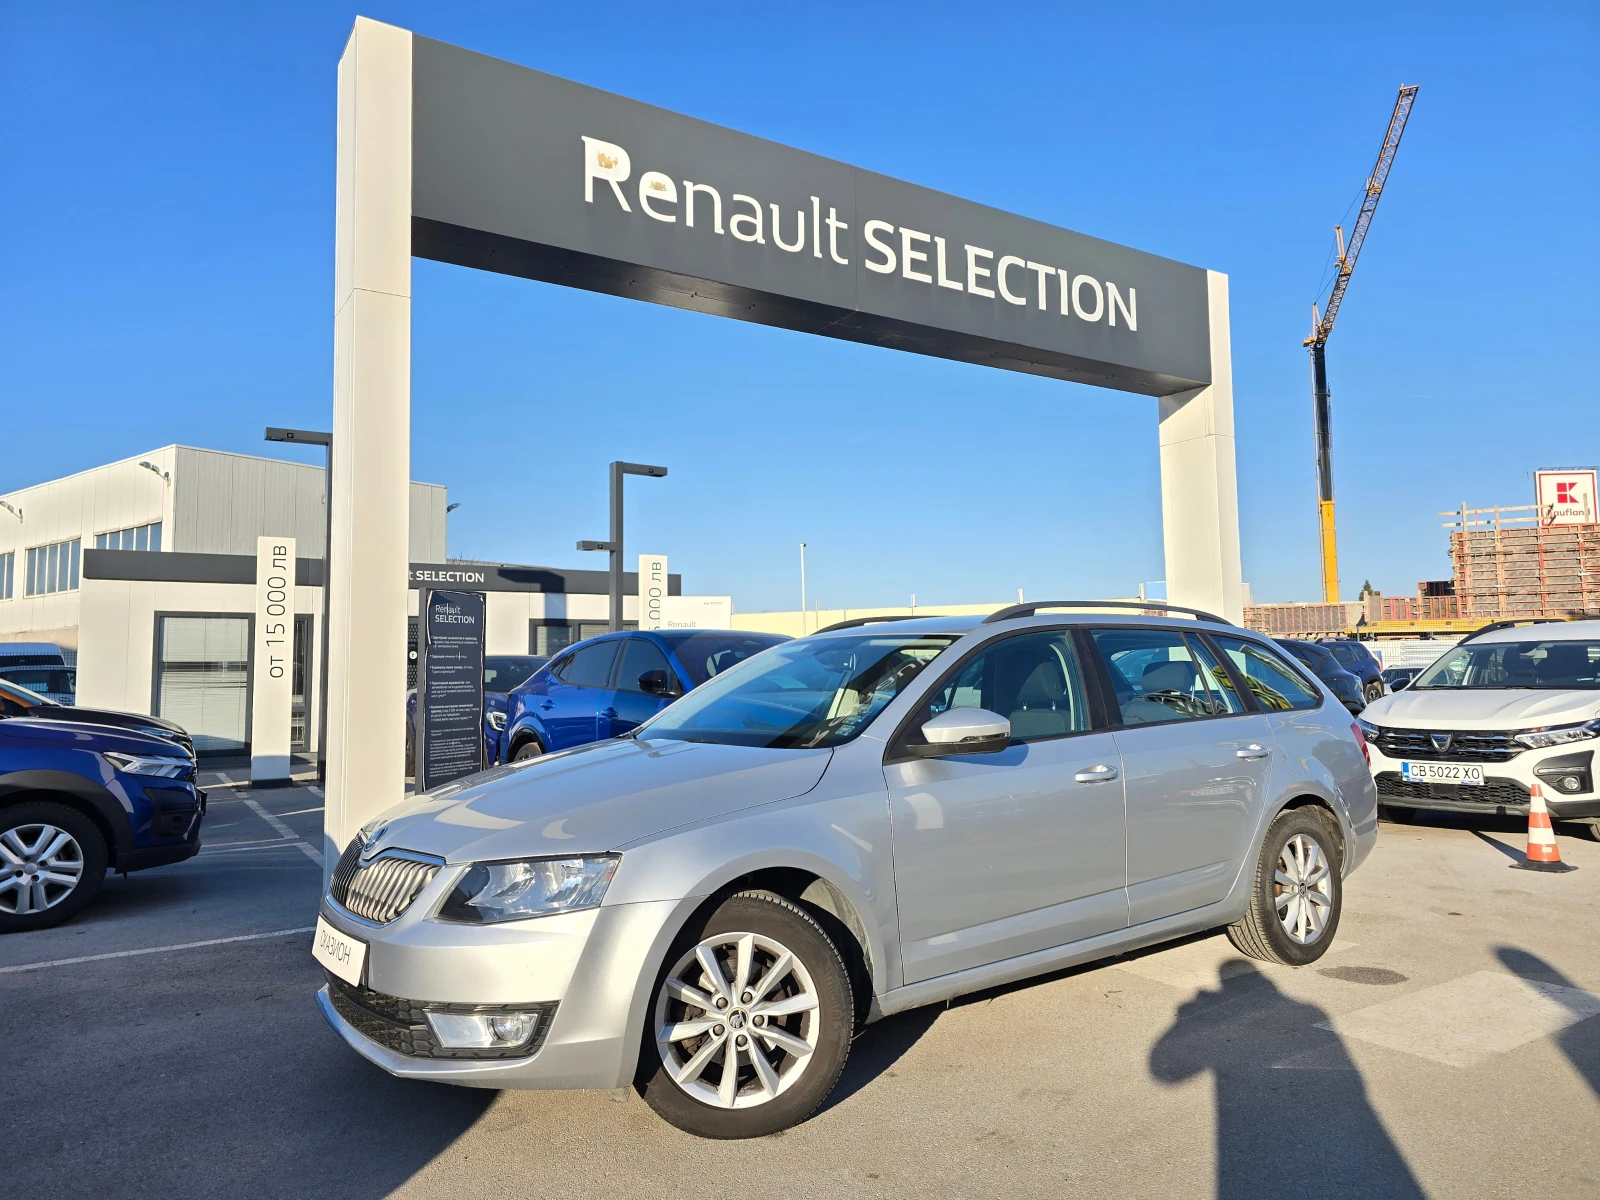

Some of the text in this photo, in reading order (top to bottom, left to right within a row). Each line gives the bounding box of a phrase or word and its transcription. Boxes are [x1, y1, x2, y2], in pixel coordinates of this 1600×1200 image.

[581, 135, 1138, 332] Renault SELECTION
[416, 570, 485, 583] SELECTION
[266, 576, 287, 617] 000
[648, 587, 662, 621] 000
[435, 604, 461, 614] Renault
[434, 614, 475, 624] SELECTION
[667, 620, 697, 628] Renault
[266, 623, 285, 647] 15
[269, 655, 284, 678] от
[1429, 765, 1460, 779] 5022
